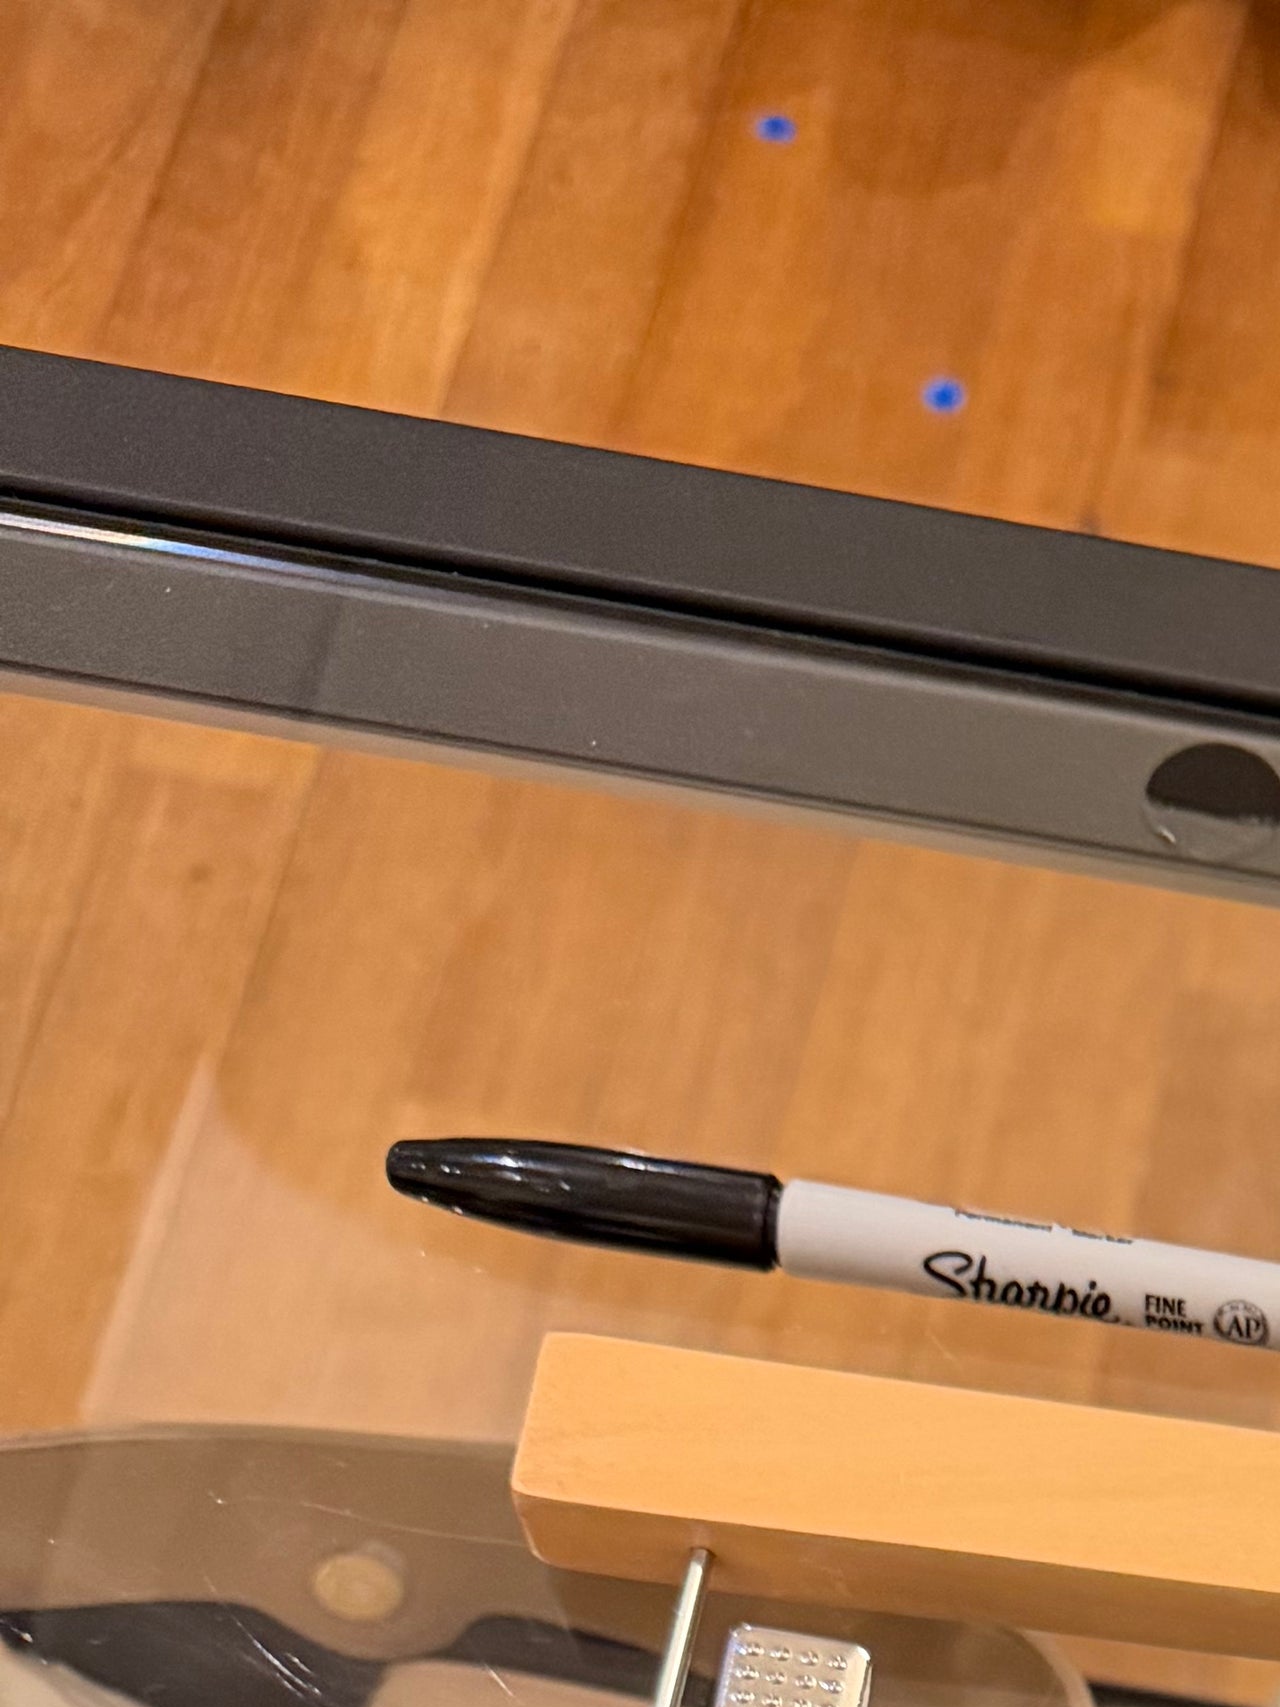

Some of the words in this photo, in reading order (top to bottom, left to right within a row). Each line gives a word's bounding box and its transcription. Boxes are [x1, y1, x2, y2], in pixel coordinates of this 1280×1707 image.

[923, 1250, 1120, 1324] Sharpie
[1144, 1294, 1186, 1318] FINE
[1144, 1315, 1202, 1335] POINT
